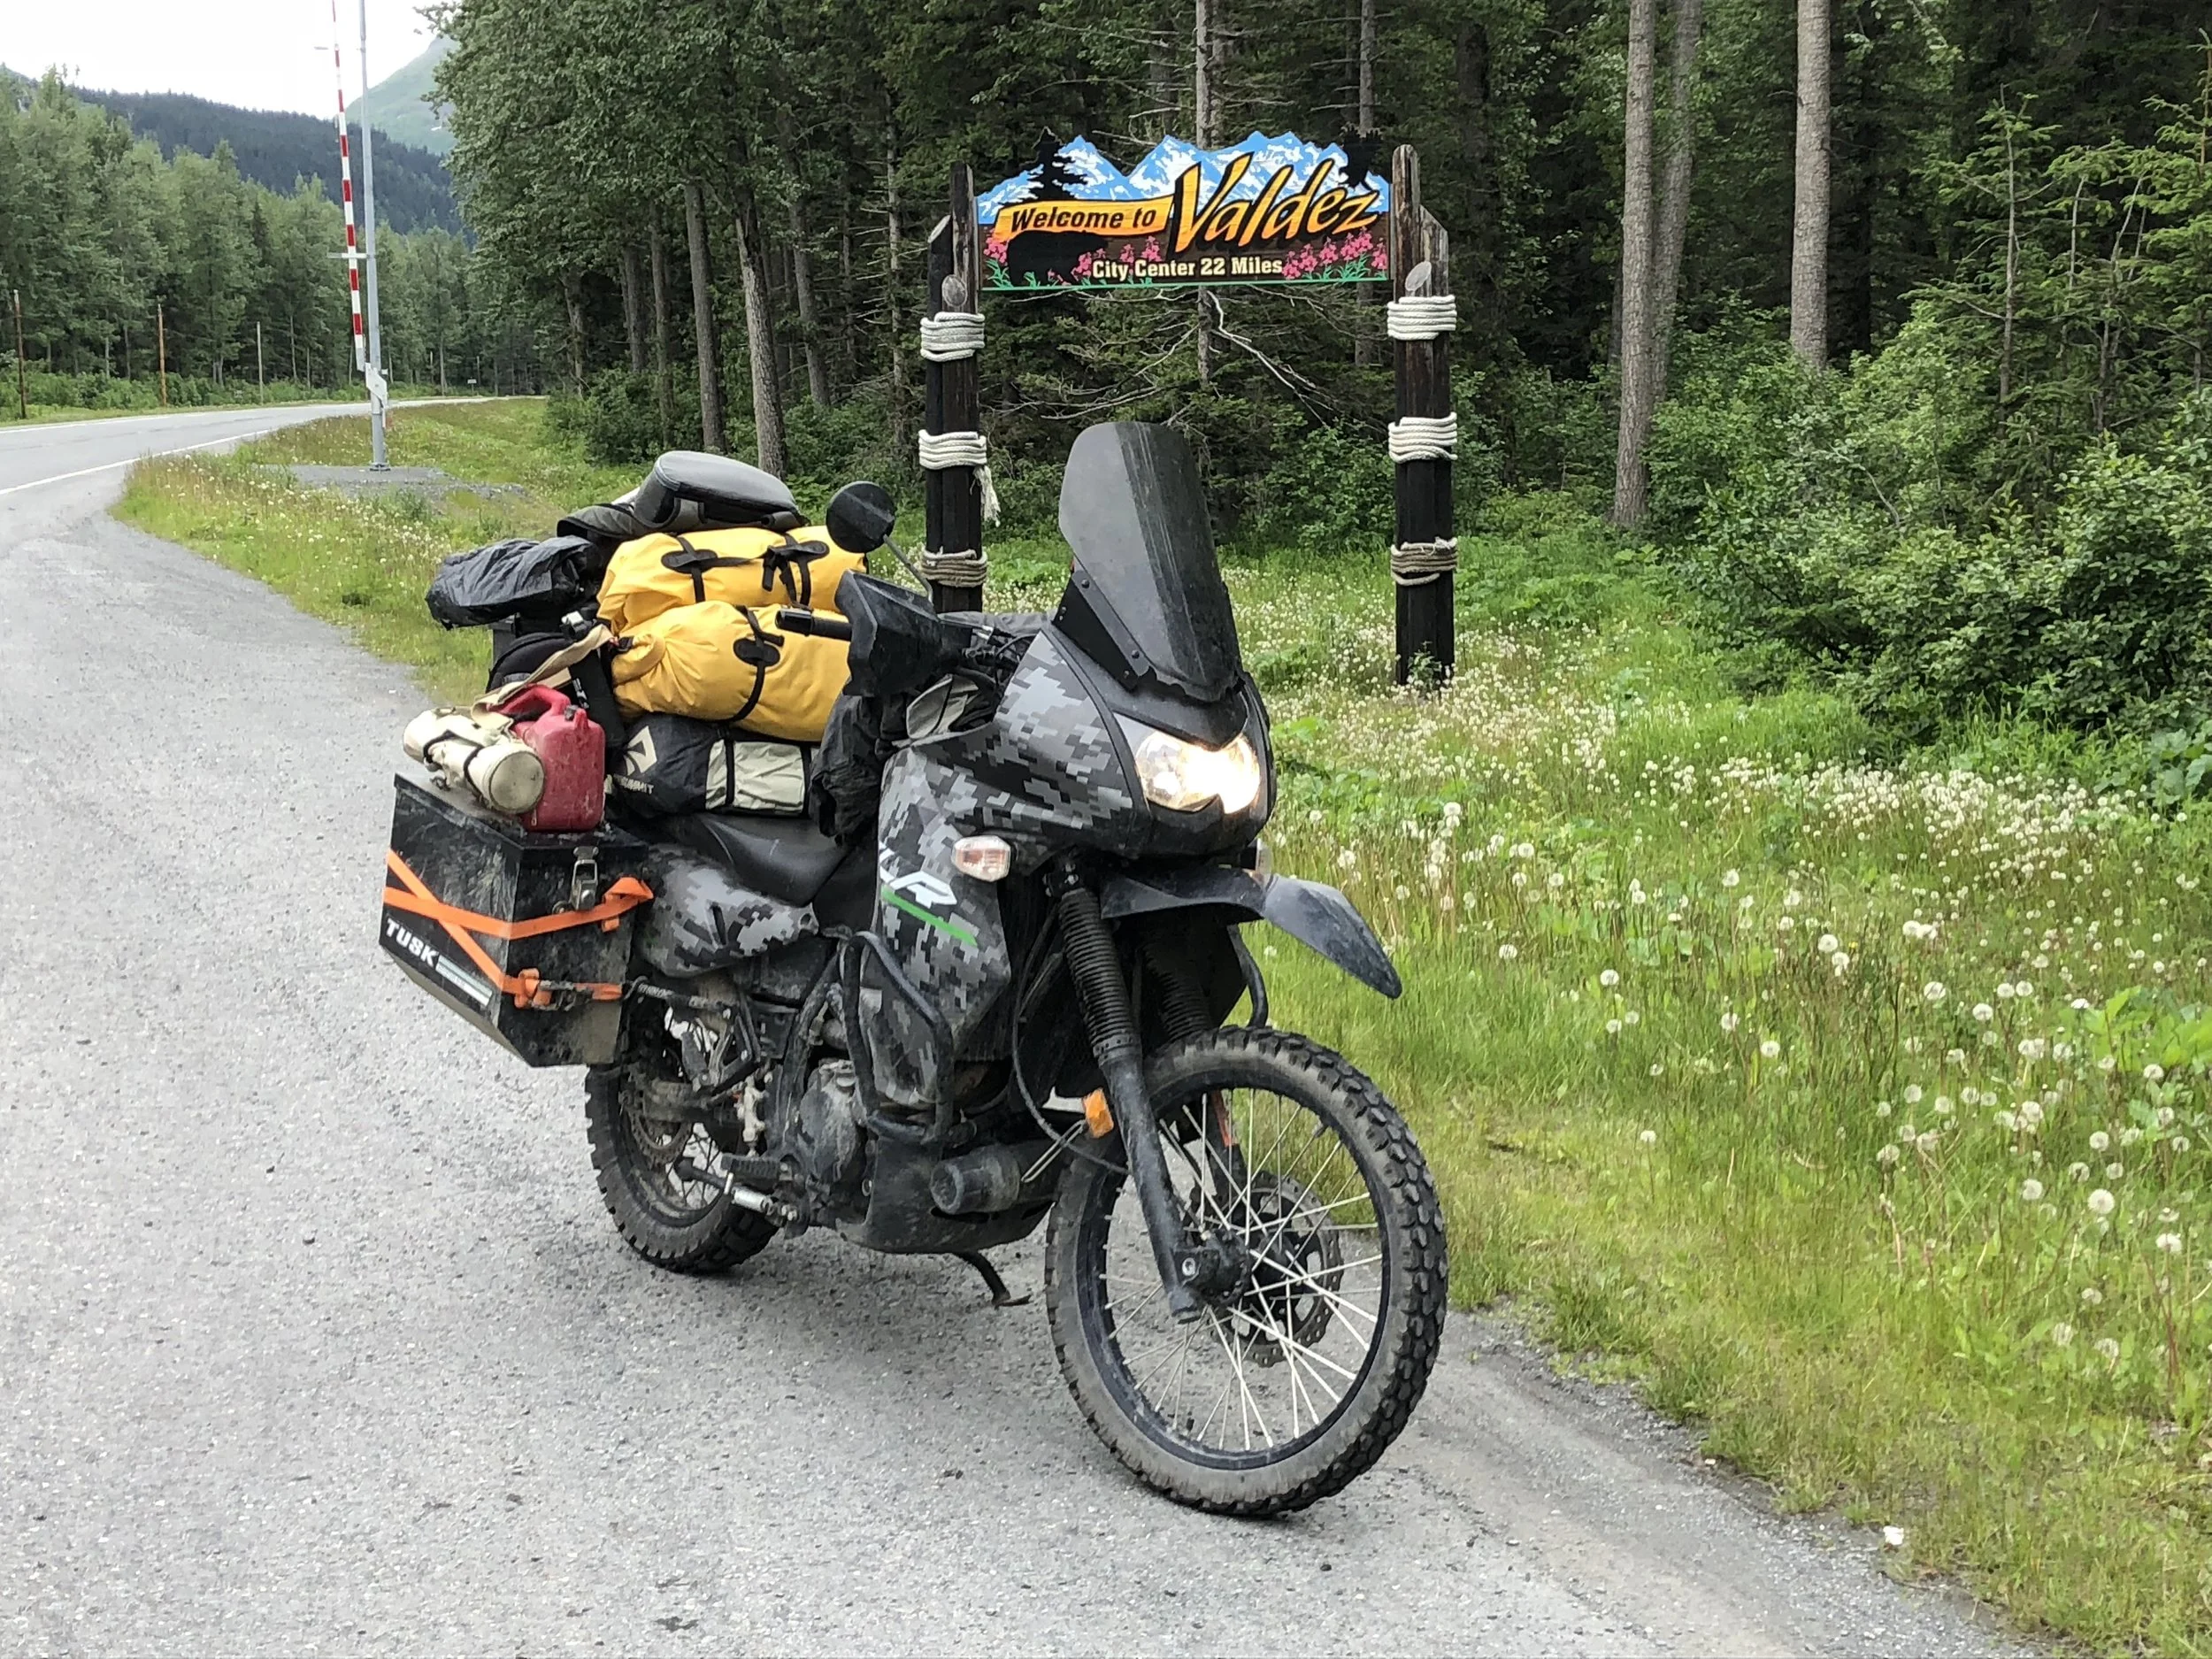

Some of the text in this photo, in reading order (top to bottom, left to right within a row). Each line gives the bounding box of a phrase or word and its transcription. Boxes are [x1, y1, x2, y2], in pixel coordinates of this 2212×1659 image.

[1011, 151, 1379, 254] Welcome to Valdez
[1093, 256, 1283, 281] City Center 22 Miles
[386, 918, 440, 968] TUSK
